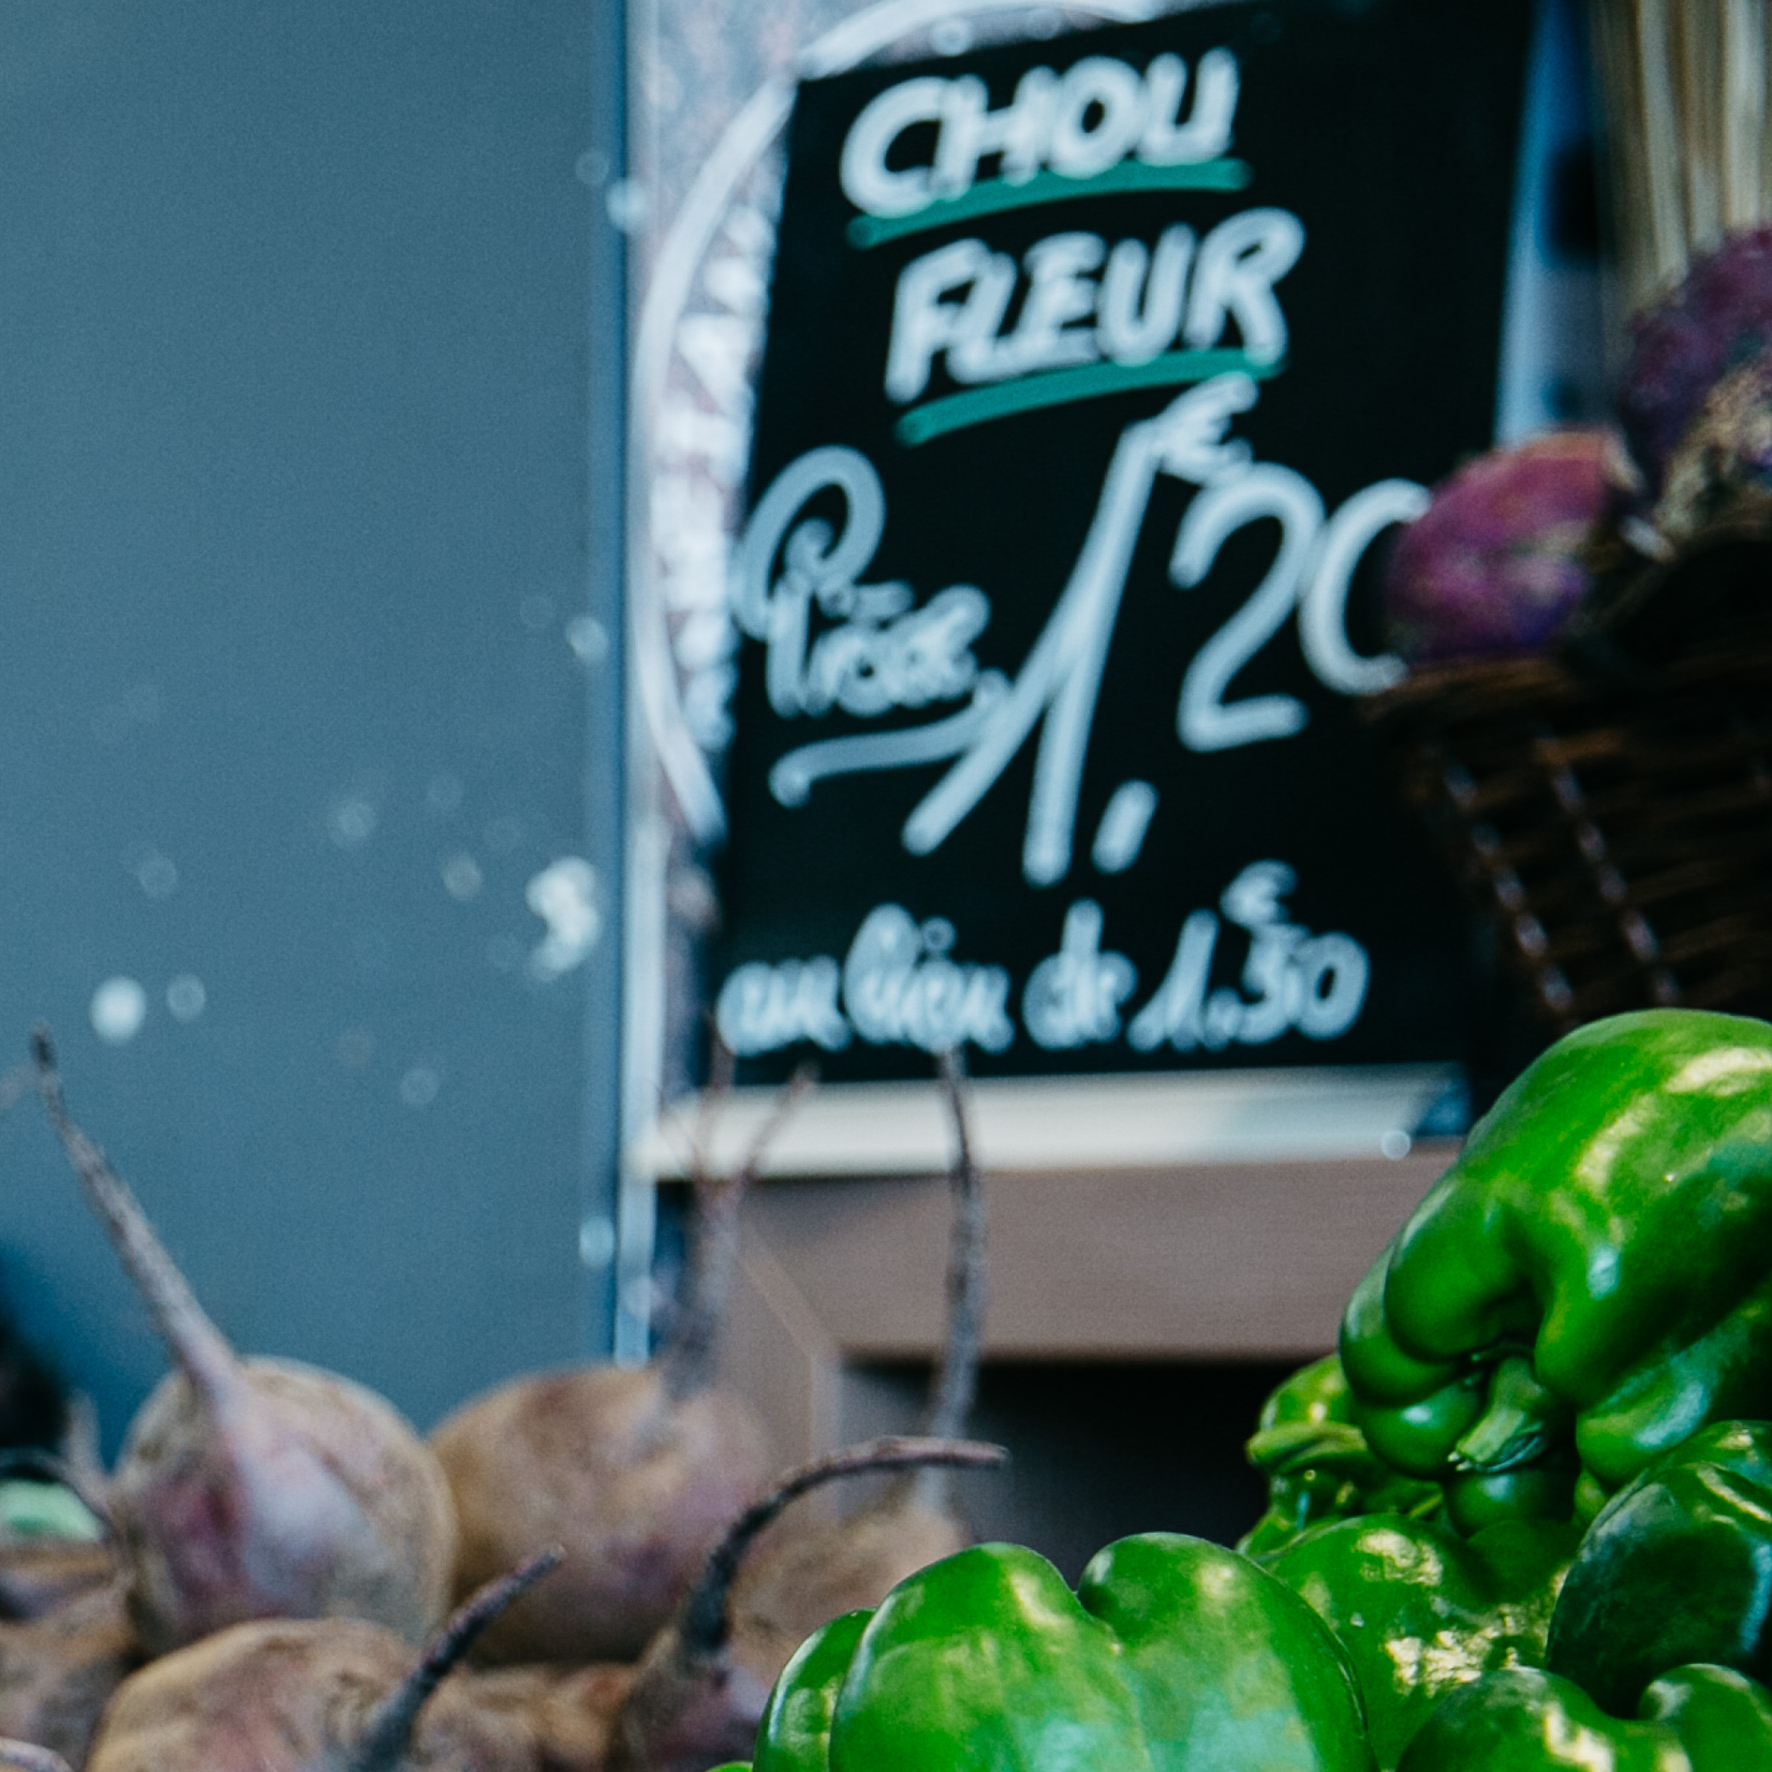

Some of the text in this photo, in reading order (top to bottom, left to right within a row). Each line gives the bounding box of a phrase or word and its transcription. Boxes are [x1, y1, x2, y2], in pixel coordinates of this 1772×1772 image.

[840, 47, 1240, 217] CHOU
[885, 207, 1305, 402] FLEUR
[717, 955, 849, 1056] au
[1023, 899, 1138, 1050] de
